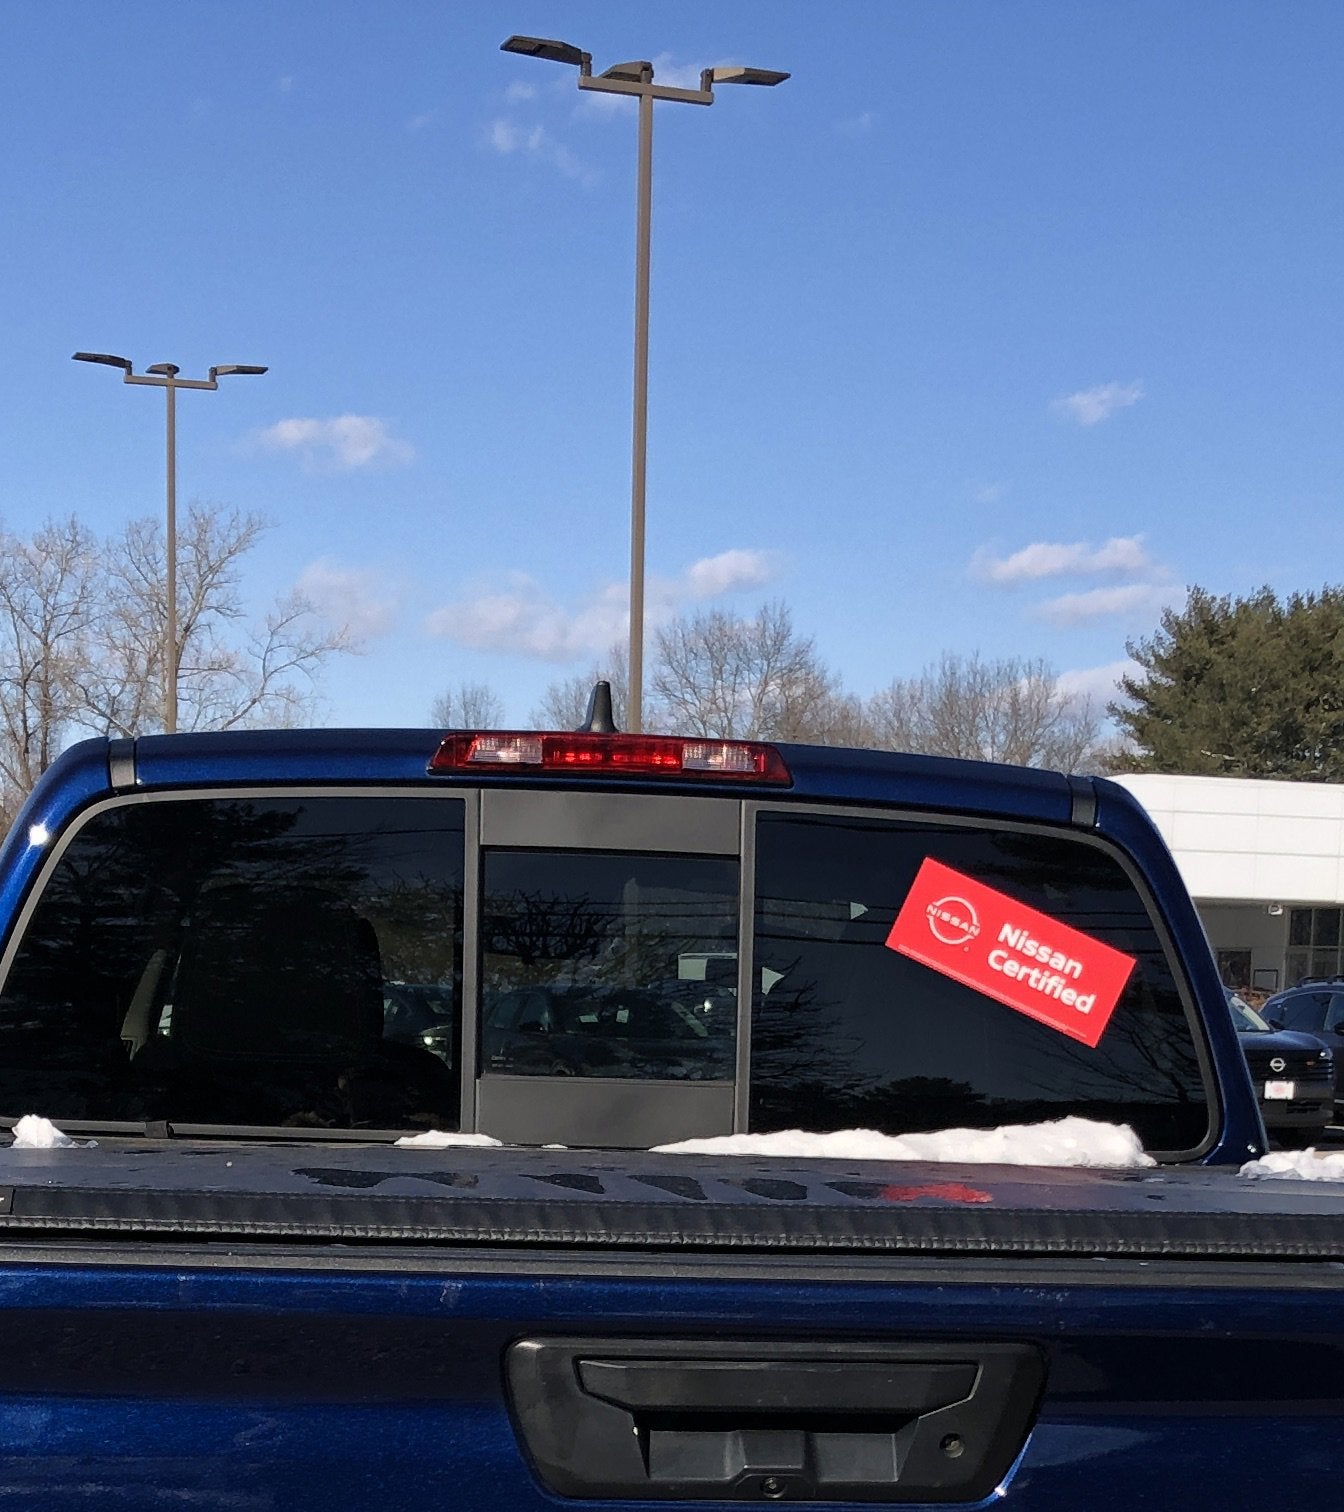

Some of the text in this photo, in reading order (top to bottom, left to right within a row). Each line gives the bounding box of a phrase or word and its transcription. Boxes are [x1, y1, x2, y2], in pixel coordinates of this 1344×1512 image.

[926, 904, 980, 937] NISSAN
[997, 923, 1083, 979] Nissan
[988, 949, 1097, 1014] Certified
